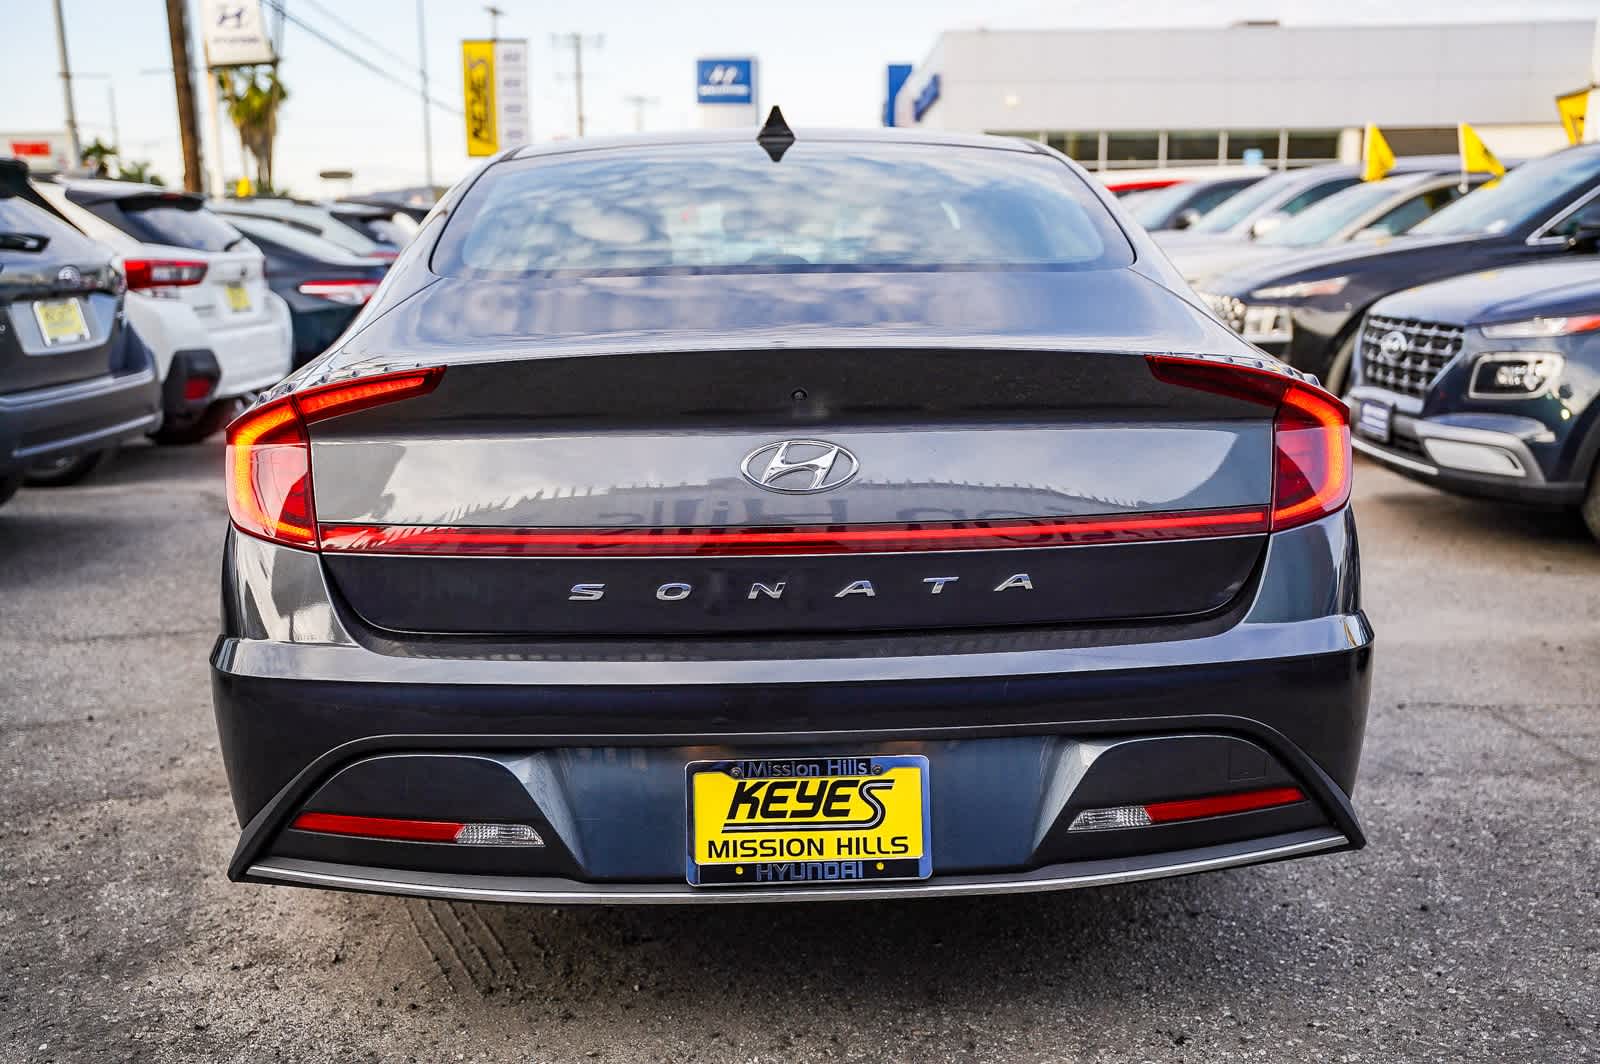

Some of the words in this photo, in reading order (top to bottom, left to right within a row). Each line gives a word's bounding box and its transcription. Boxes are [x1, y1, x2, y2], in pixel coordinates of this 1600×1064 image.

[568, 573, 1034, 600] SONATA
[749, 760, 820, 778] Mission
[827, 758, 868, 776] Hills
[722, 779, 895, 833] KEYES
[707, 838, 824, 858] MISSION
[836, 836, 909, 855] HILLS
[756, 861, 864, 881] HYUNDAI
